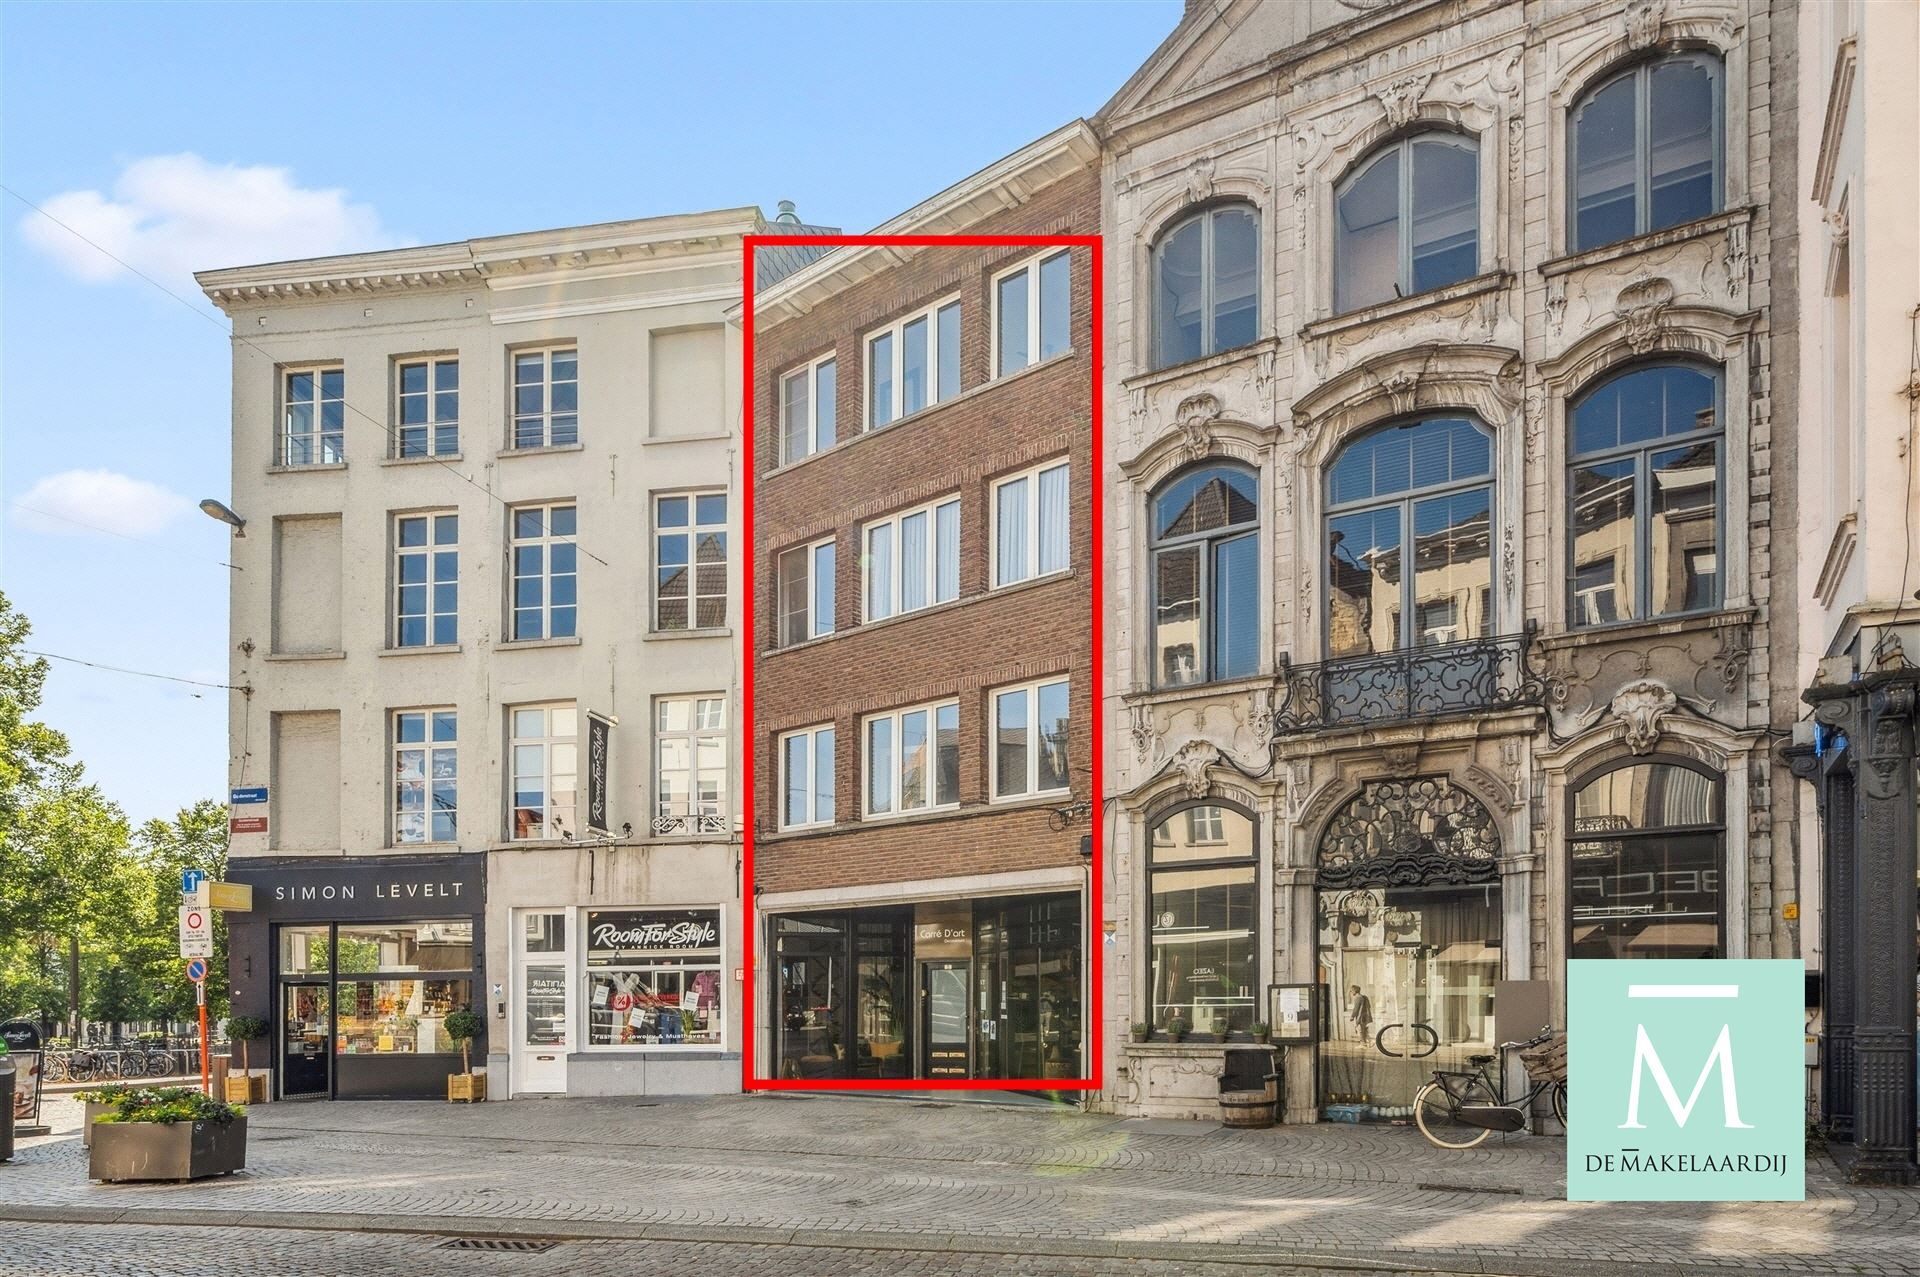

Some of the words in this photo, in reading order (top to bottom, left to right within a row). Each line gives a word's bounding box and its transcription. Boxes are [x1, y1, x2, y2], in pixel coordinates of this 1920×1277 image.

[275, 885, 355, 900] SIMON
[592, 921, 716, 948] RoomForStyle
[920, 929, 943, 939] Carré
[944, 929, 965, 938] D'art
